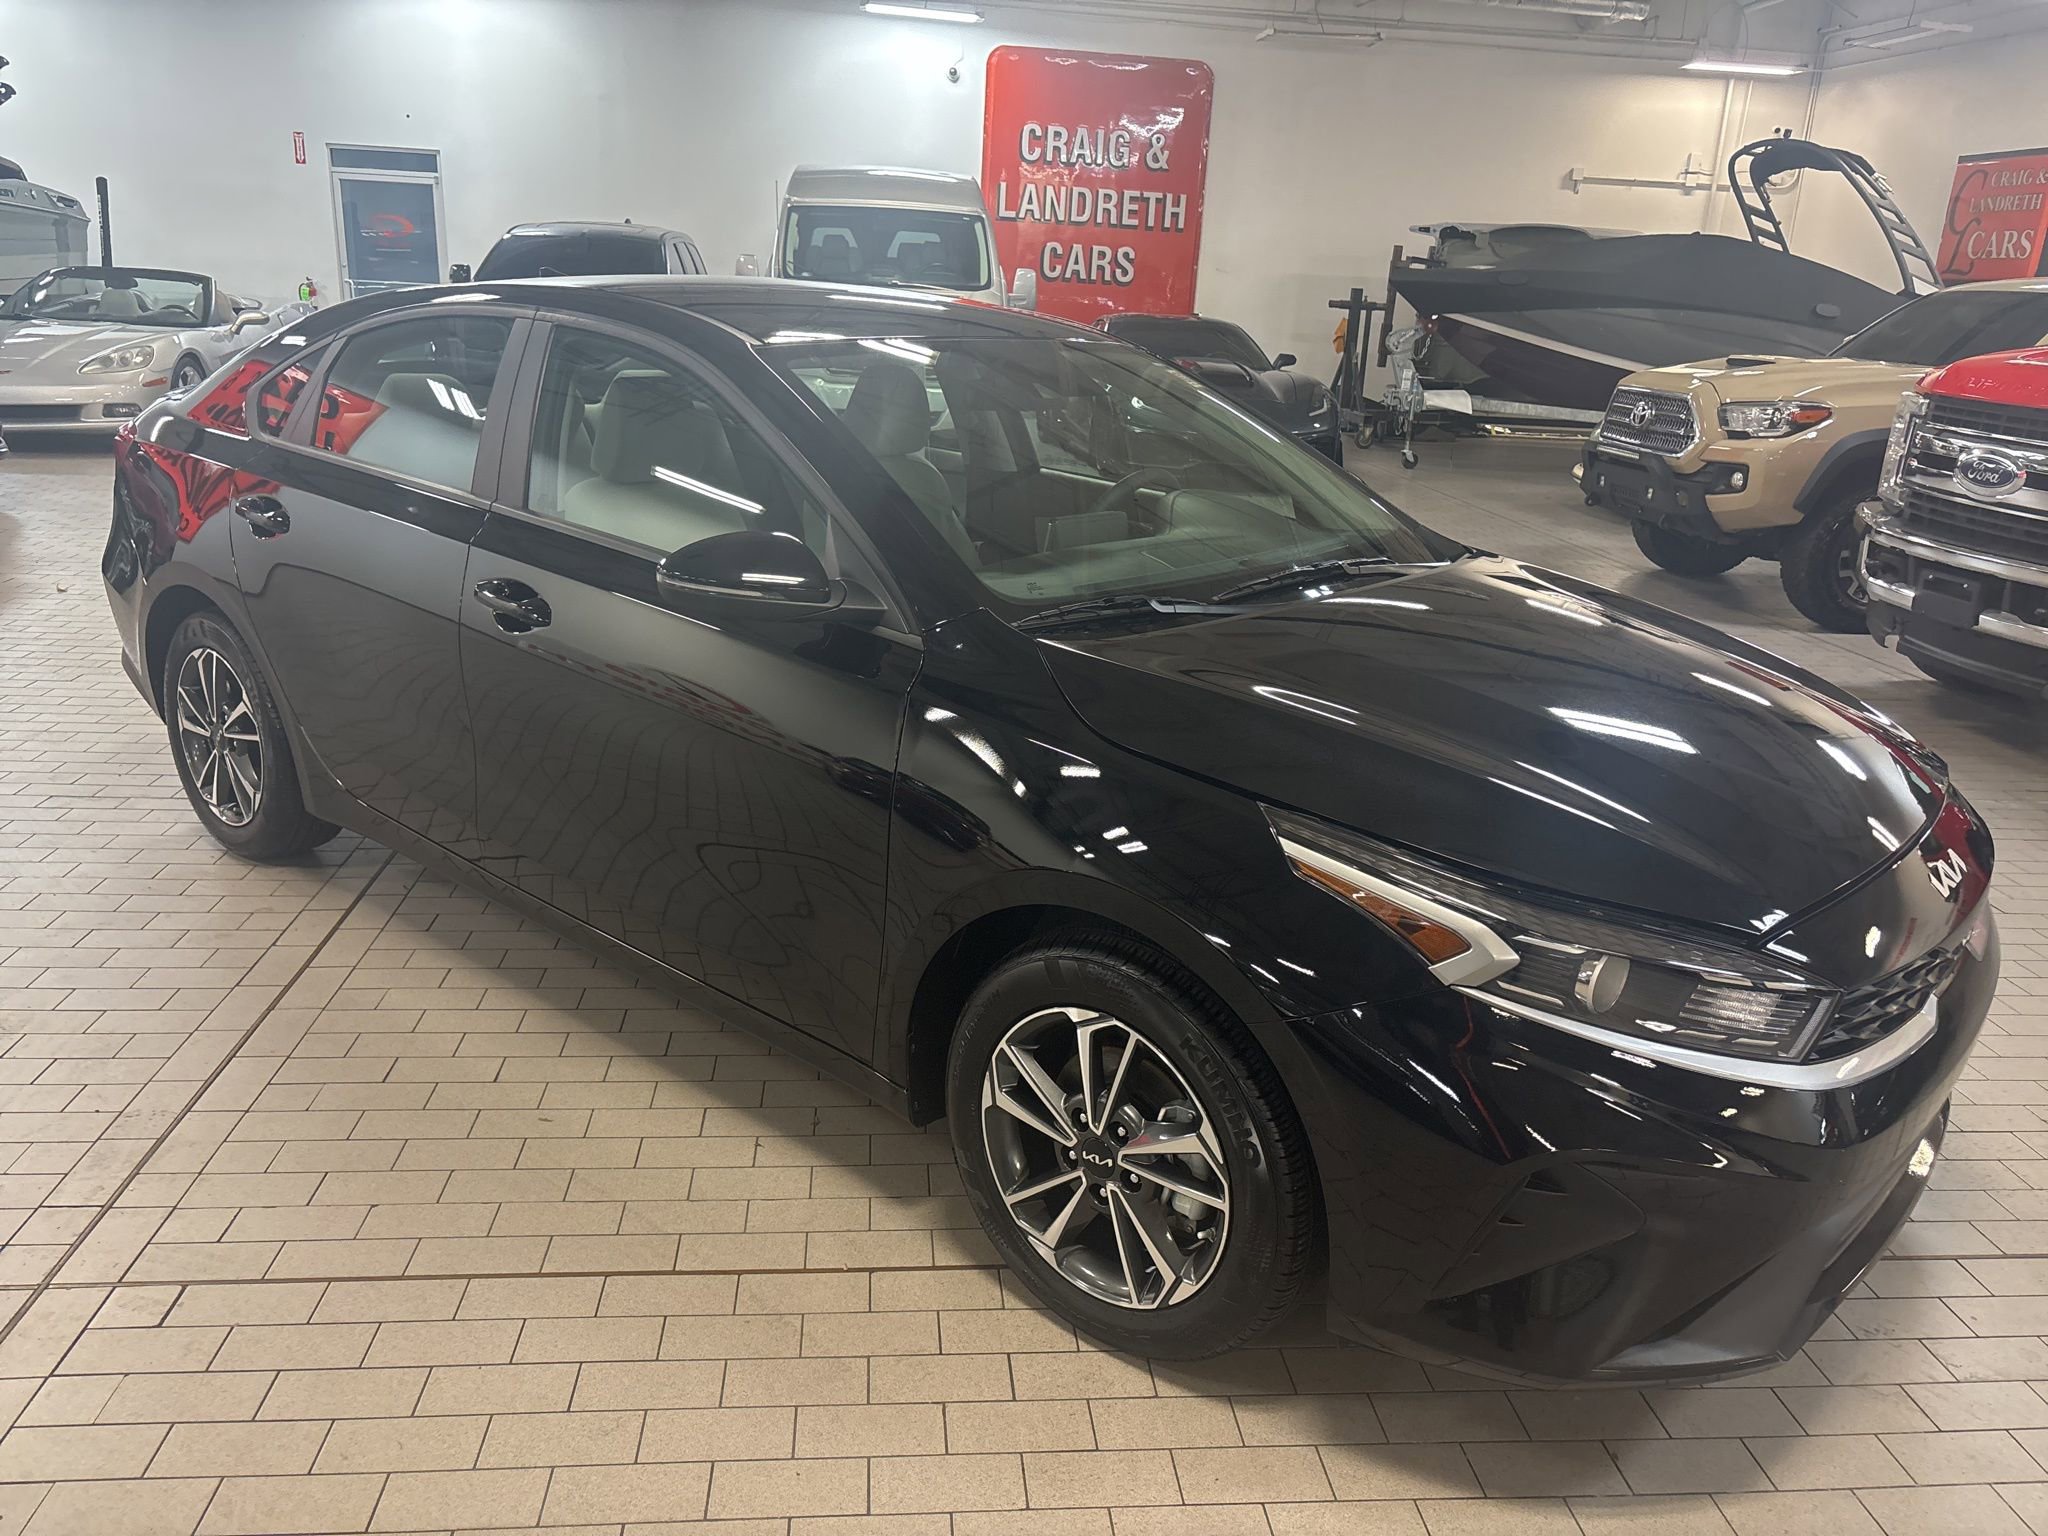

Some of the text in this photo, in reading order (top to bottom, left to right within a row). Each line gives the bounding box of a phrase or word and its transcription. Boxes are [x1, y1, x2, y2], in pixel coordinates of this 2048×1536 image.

[1019, 122, 1170, 171] CRAIG &
[1990, 167, 2048, 187] CRAIG &
[996, 180, 1187, 232] LANDRETH
[1968, 193, 2044, 213] LANDRETH
[1967, 229, 2035, 259] CARS
[1040, 241, 1136, 284] CARS
[1967, 459, 2003, 484] Ford
